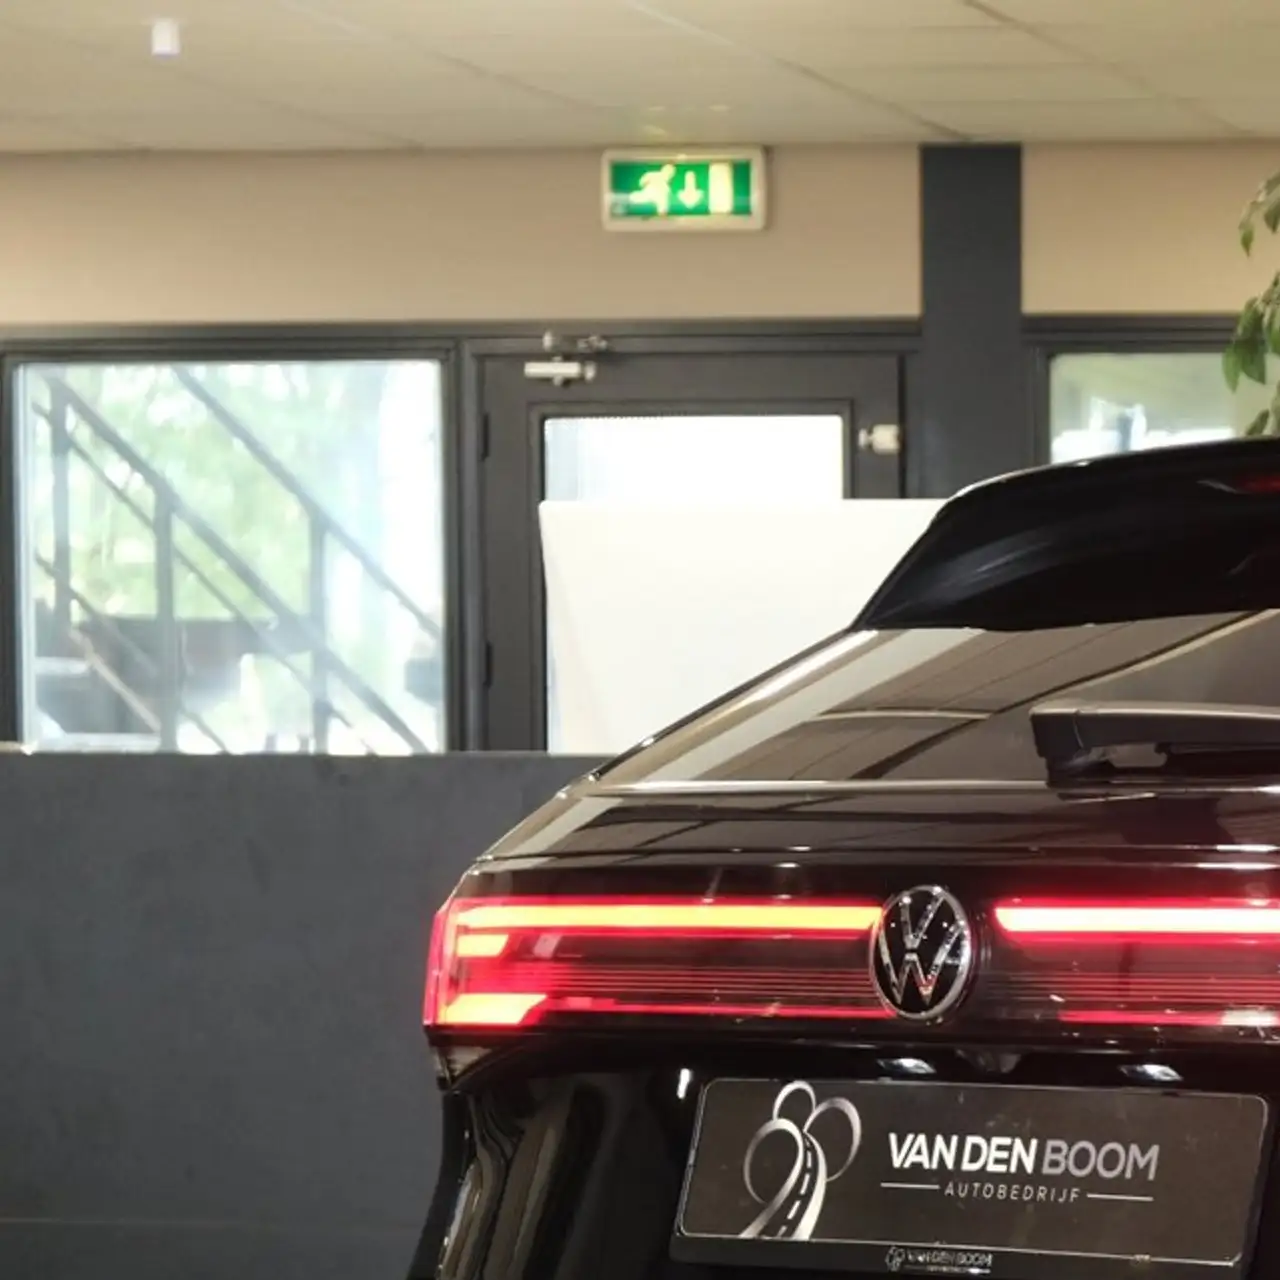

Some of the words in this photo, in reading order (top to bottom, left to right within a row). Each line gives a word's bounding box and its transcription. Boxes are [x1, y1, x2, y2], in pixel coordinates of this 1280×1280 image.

[888, 1132, 959, 1170] VAN
[960, 1135, 1038, 1175] DEN
[1041, 1139, 1160, 1181] BOOM
[943, 1181, 1081, 1203] AUTOBEDRIJF
